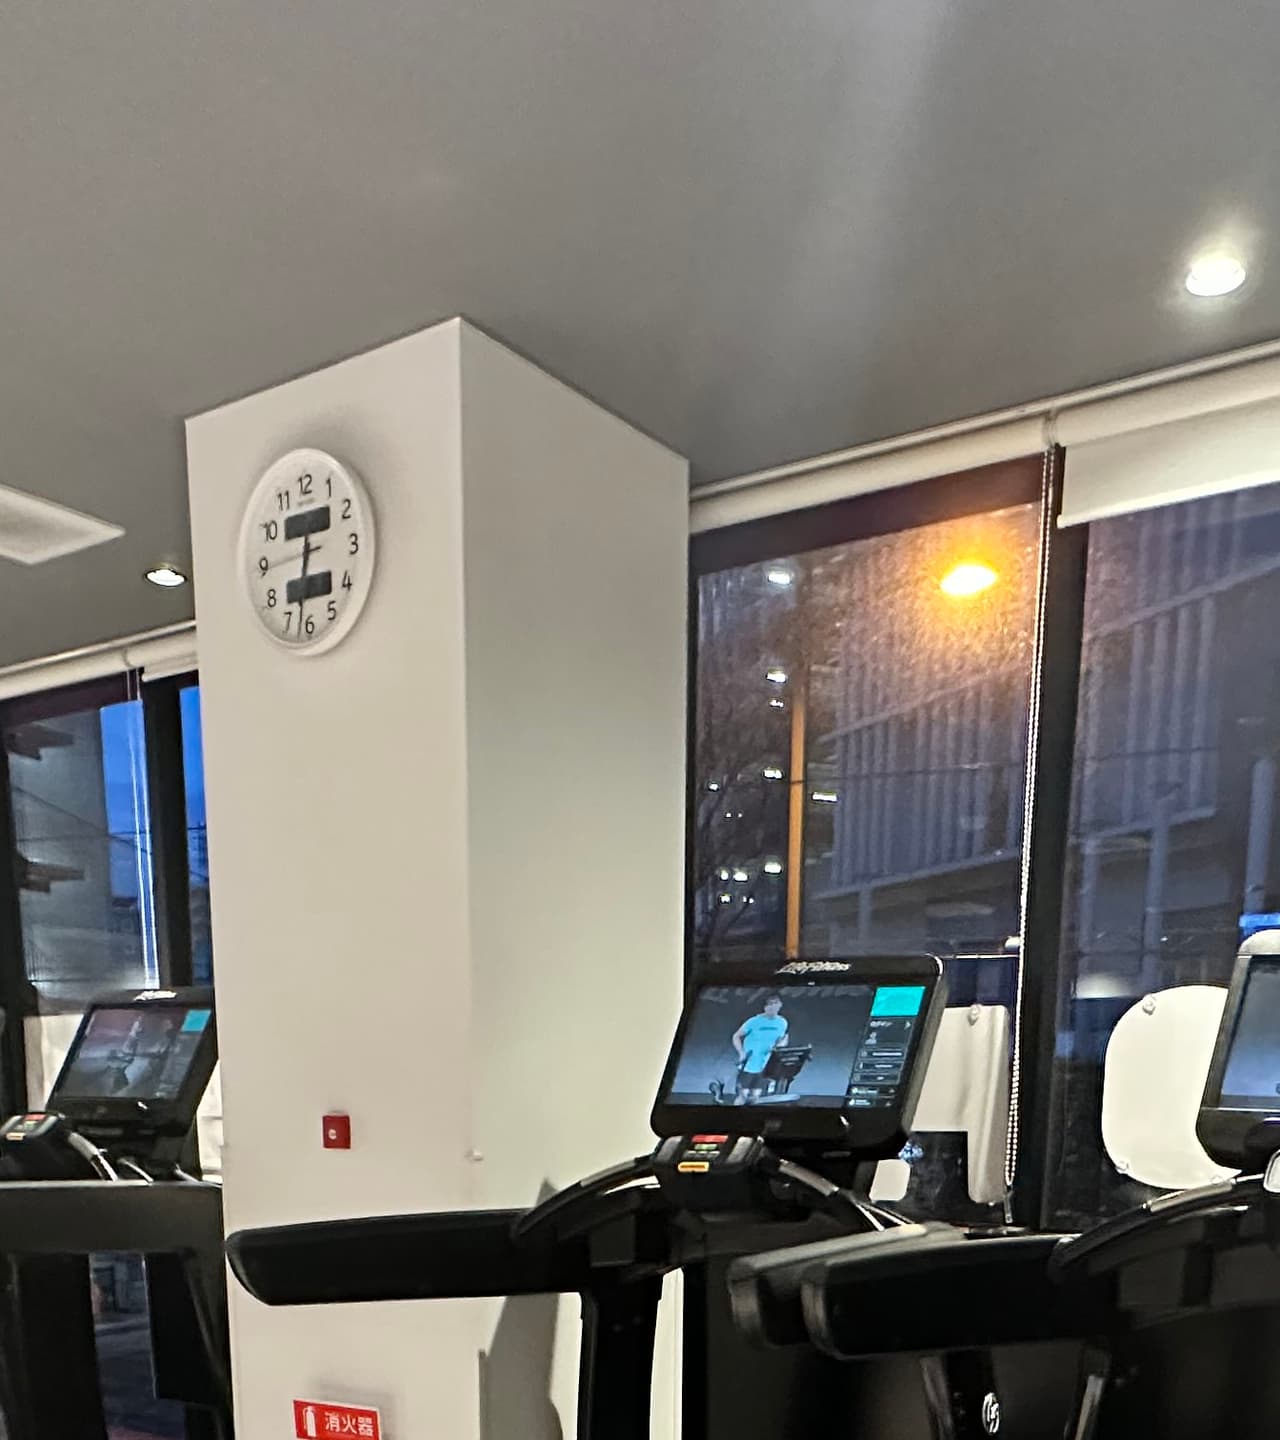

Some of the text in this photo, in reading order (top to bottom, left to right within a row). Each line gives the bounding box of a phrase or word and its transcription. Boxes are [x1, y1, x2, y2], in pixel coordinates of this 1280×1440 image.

[297, 474, 313, 496] 12
[326, 478, 333, 498] 1
[278, 490, 290, 511] 11
[342, 499, 352, 520] 2
[262, 520, 278, 541] 10
[348, 533, 359, 555] 3
[259, 557, 269, 577] 9
[342, 571, 352, 591] 4
[267, 589, 277, 608] 8
[283, 611, 293, 632] 7
[327, 601, 337, 621] 5
[305, 614, 315, 635] 6
[324, 1411, 374, 1438] 消火器
